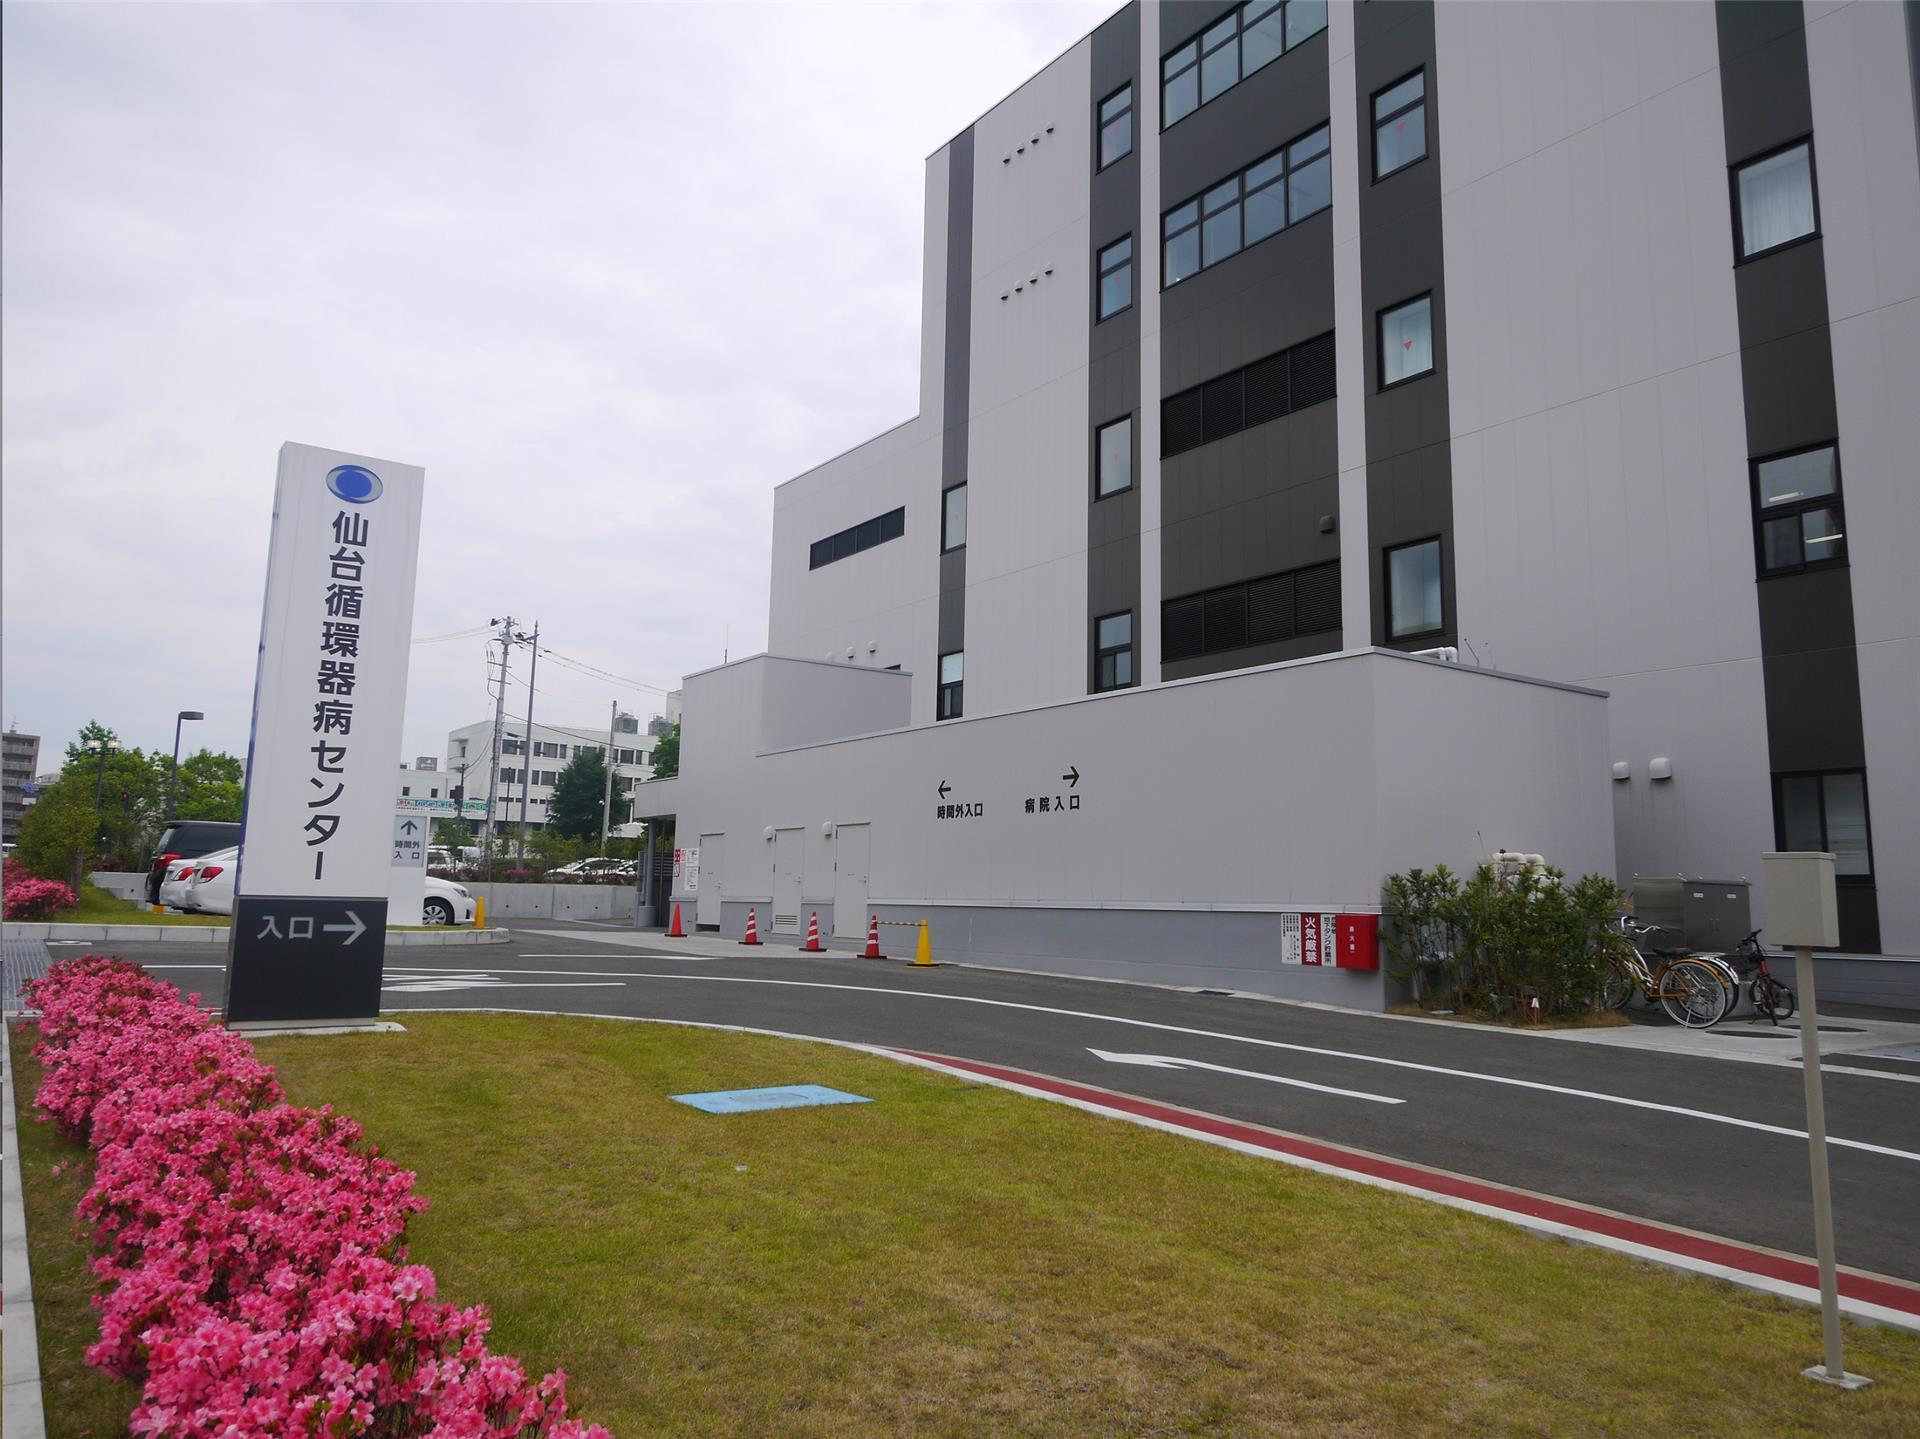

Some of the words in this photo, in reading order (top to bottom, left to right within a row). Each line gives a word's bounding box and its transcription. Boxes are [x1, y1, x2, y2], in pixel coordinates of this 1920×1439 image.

[303, 511, 369, 881] 仙台循環器病センター
[936, 803, 983, 819] 時間外入口
[1024, 795, 1080, 813] 病院入口
[394, 841, 420, 849] 時間外
[257, 915, 315, 939] 入口
[1305, 917, 1317, 963] 火気厳禁
